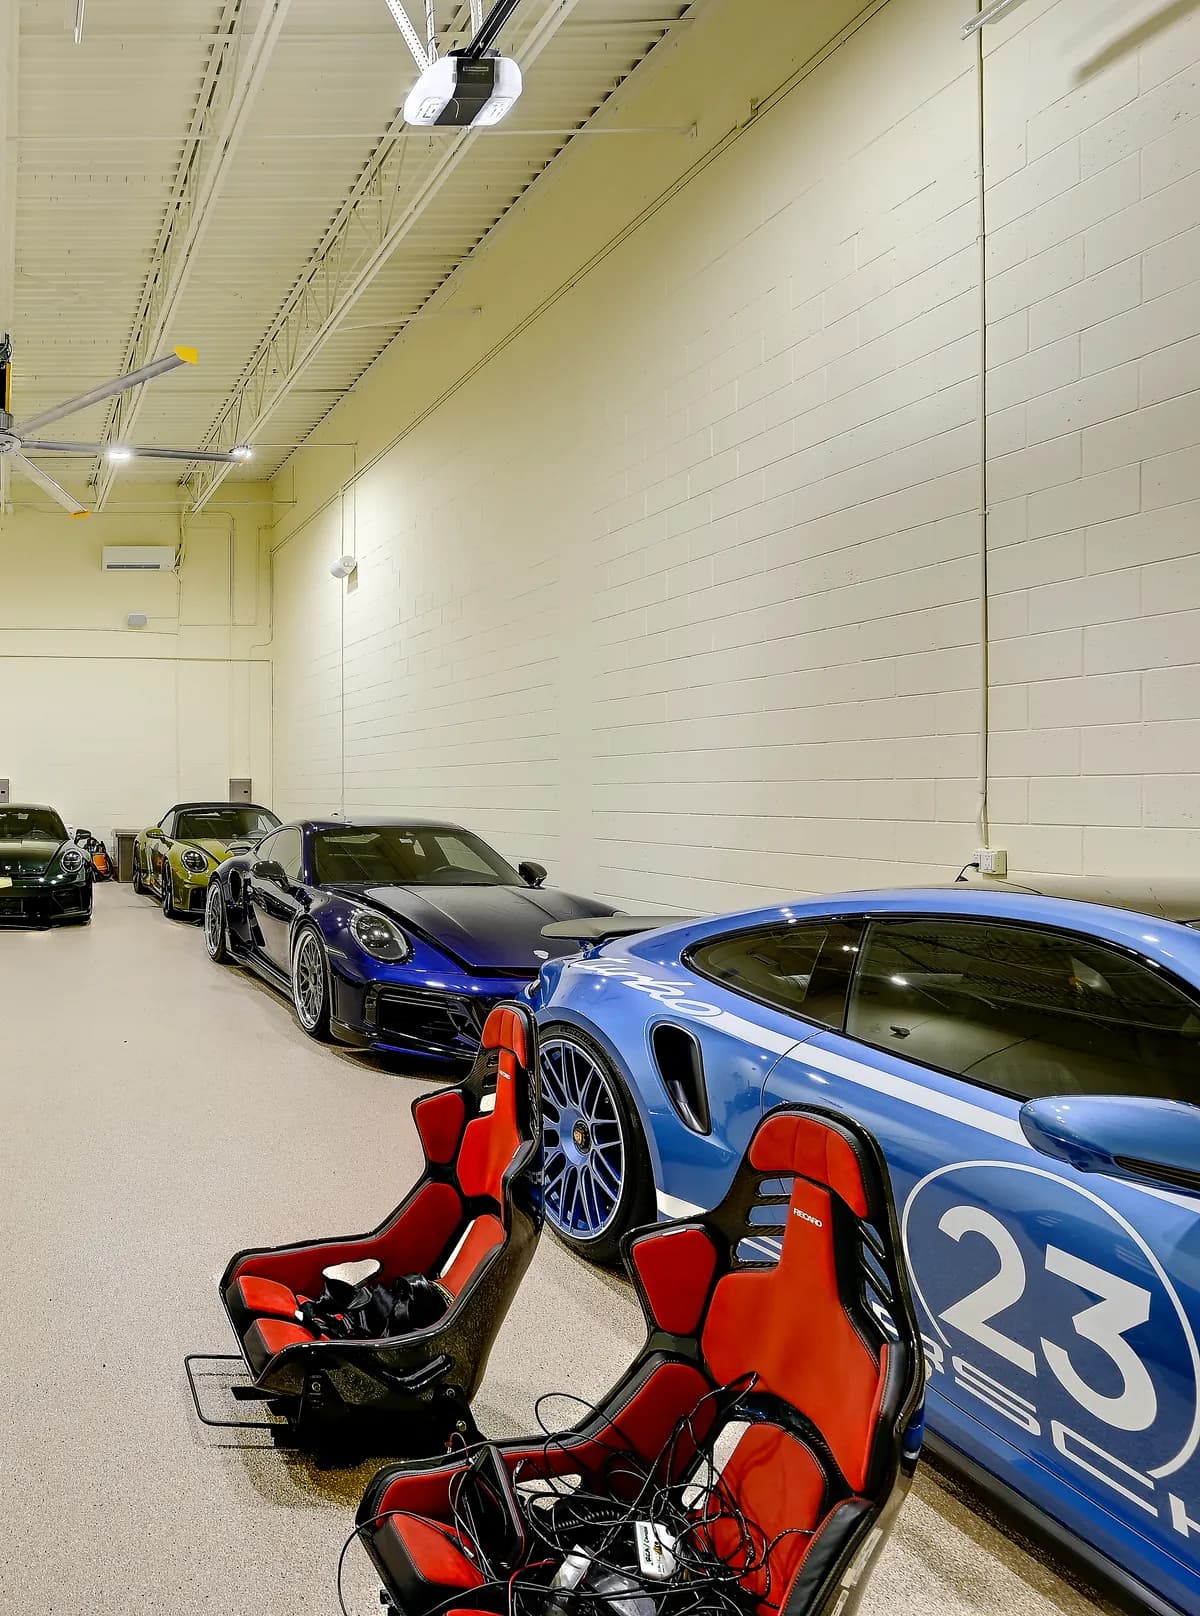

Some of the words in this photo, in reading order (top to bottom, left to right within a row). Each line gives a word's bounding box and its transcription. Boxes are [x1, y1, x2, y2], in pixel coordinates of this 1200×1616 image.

[568, 957, 722, 1018] turbo
[793, 1207, 823, 1228] RECARO
[937, 1205, 1158, 1432] 23
